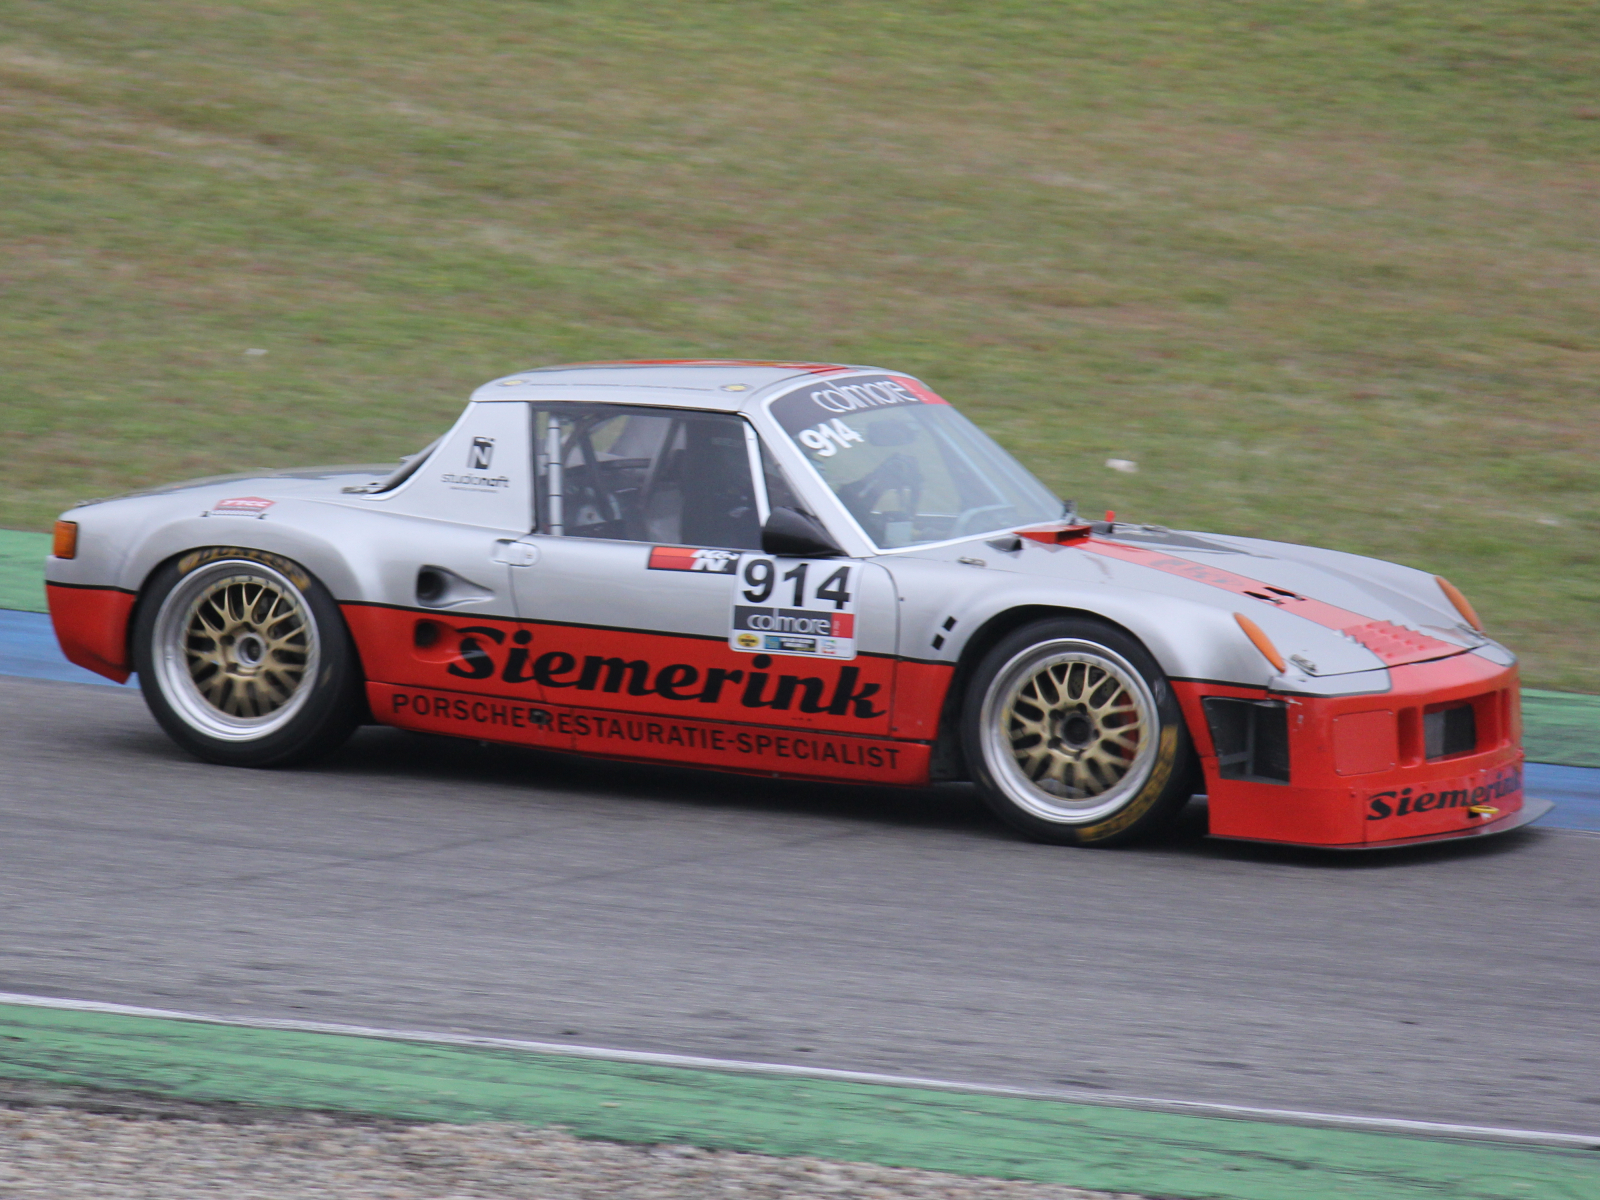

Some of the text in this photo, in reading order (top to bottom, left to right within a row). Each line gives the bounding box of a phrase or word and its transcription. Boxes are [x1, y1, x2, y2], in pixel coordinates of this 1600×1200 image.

[810, 380, 919, 413] colmore
[798, 417, 865, 457] 914
[742, 558, 852, 610] 914
[747, 608, 831, 636] colmore
[447, 626, 887, 719] Siemerink
[392, 693, 901, 769] PORSCHERESTAURATIE-SPECIALIST
